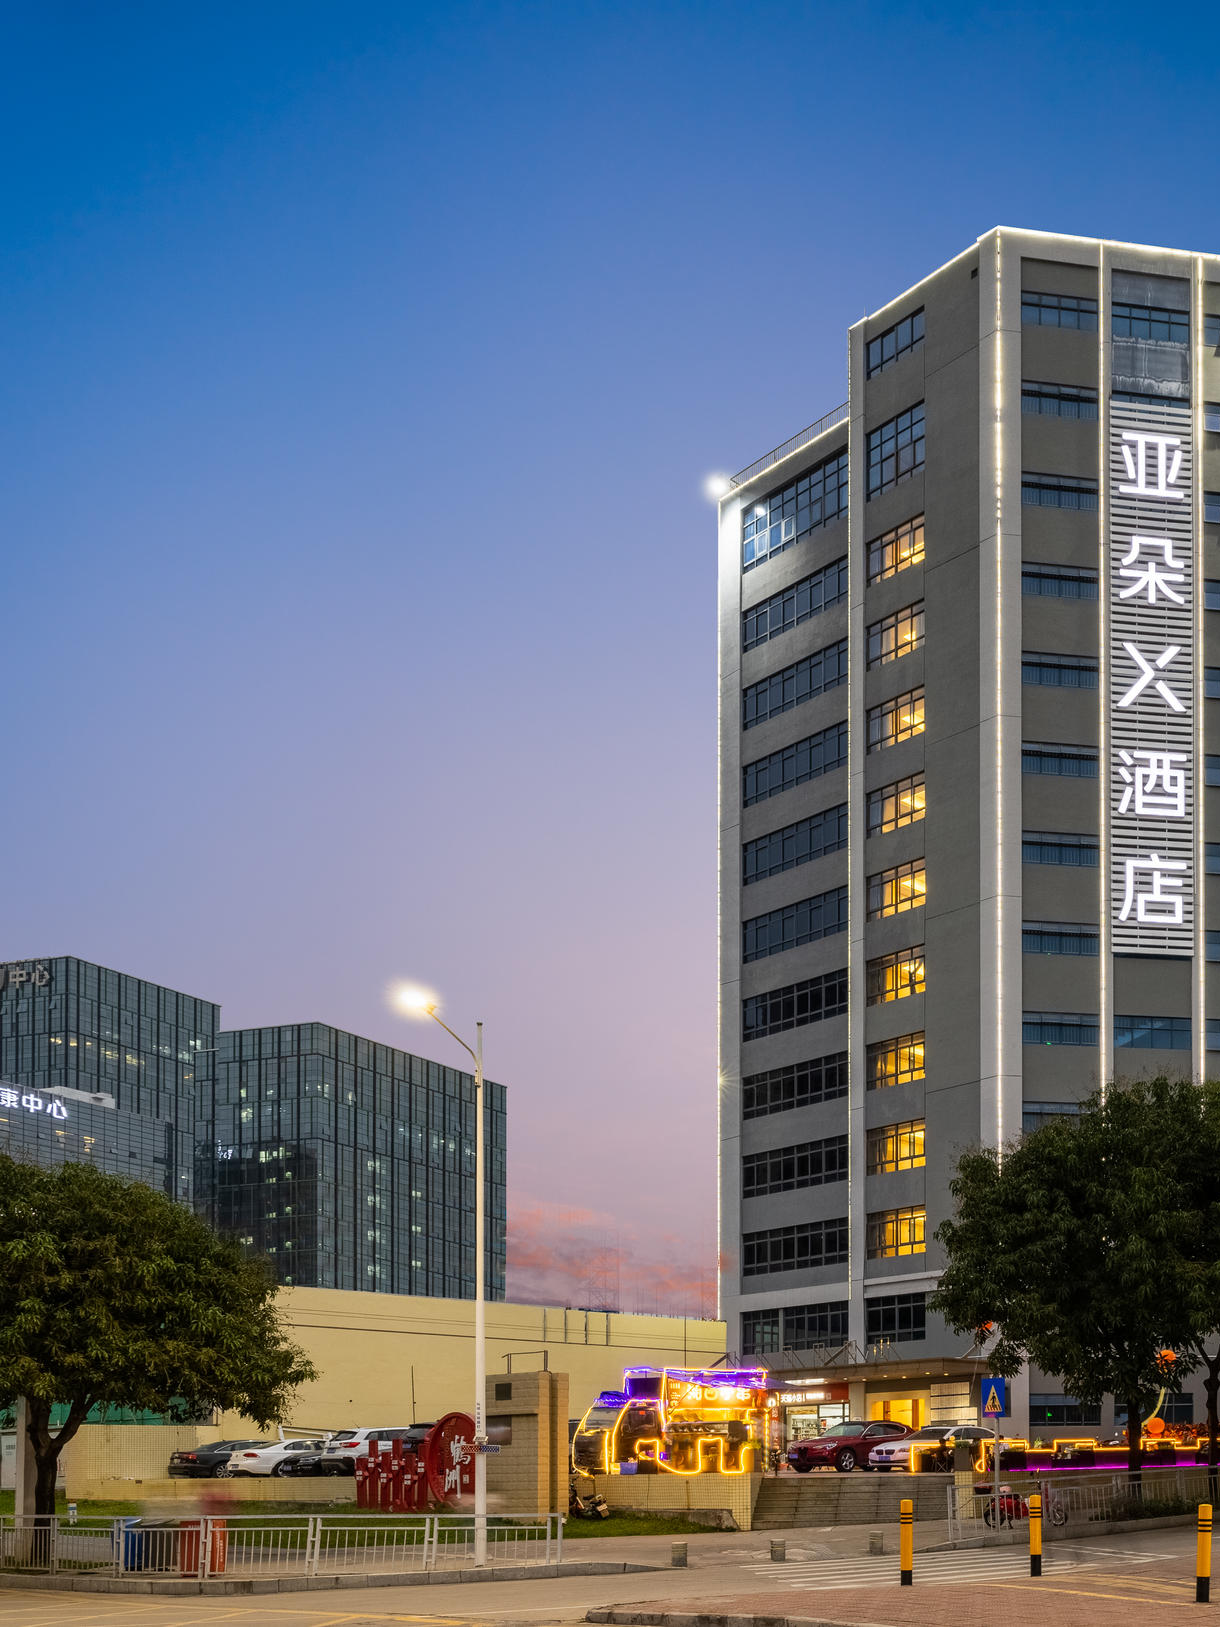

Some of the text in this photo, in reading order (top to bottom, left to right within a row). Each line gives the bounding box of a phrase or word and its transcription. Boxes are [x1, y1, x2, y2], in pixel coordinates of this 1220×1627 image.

[1116, 432, 1187, 926] 亚朵X酒店
[0, 965, 50, 989] 中心
